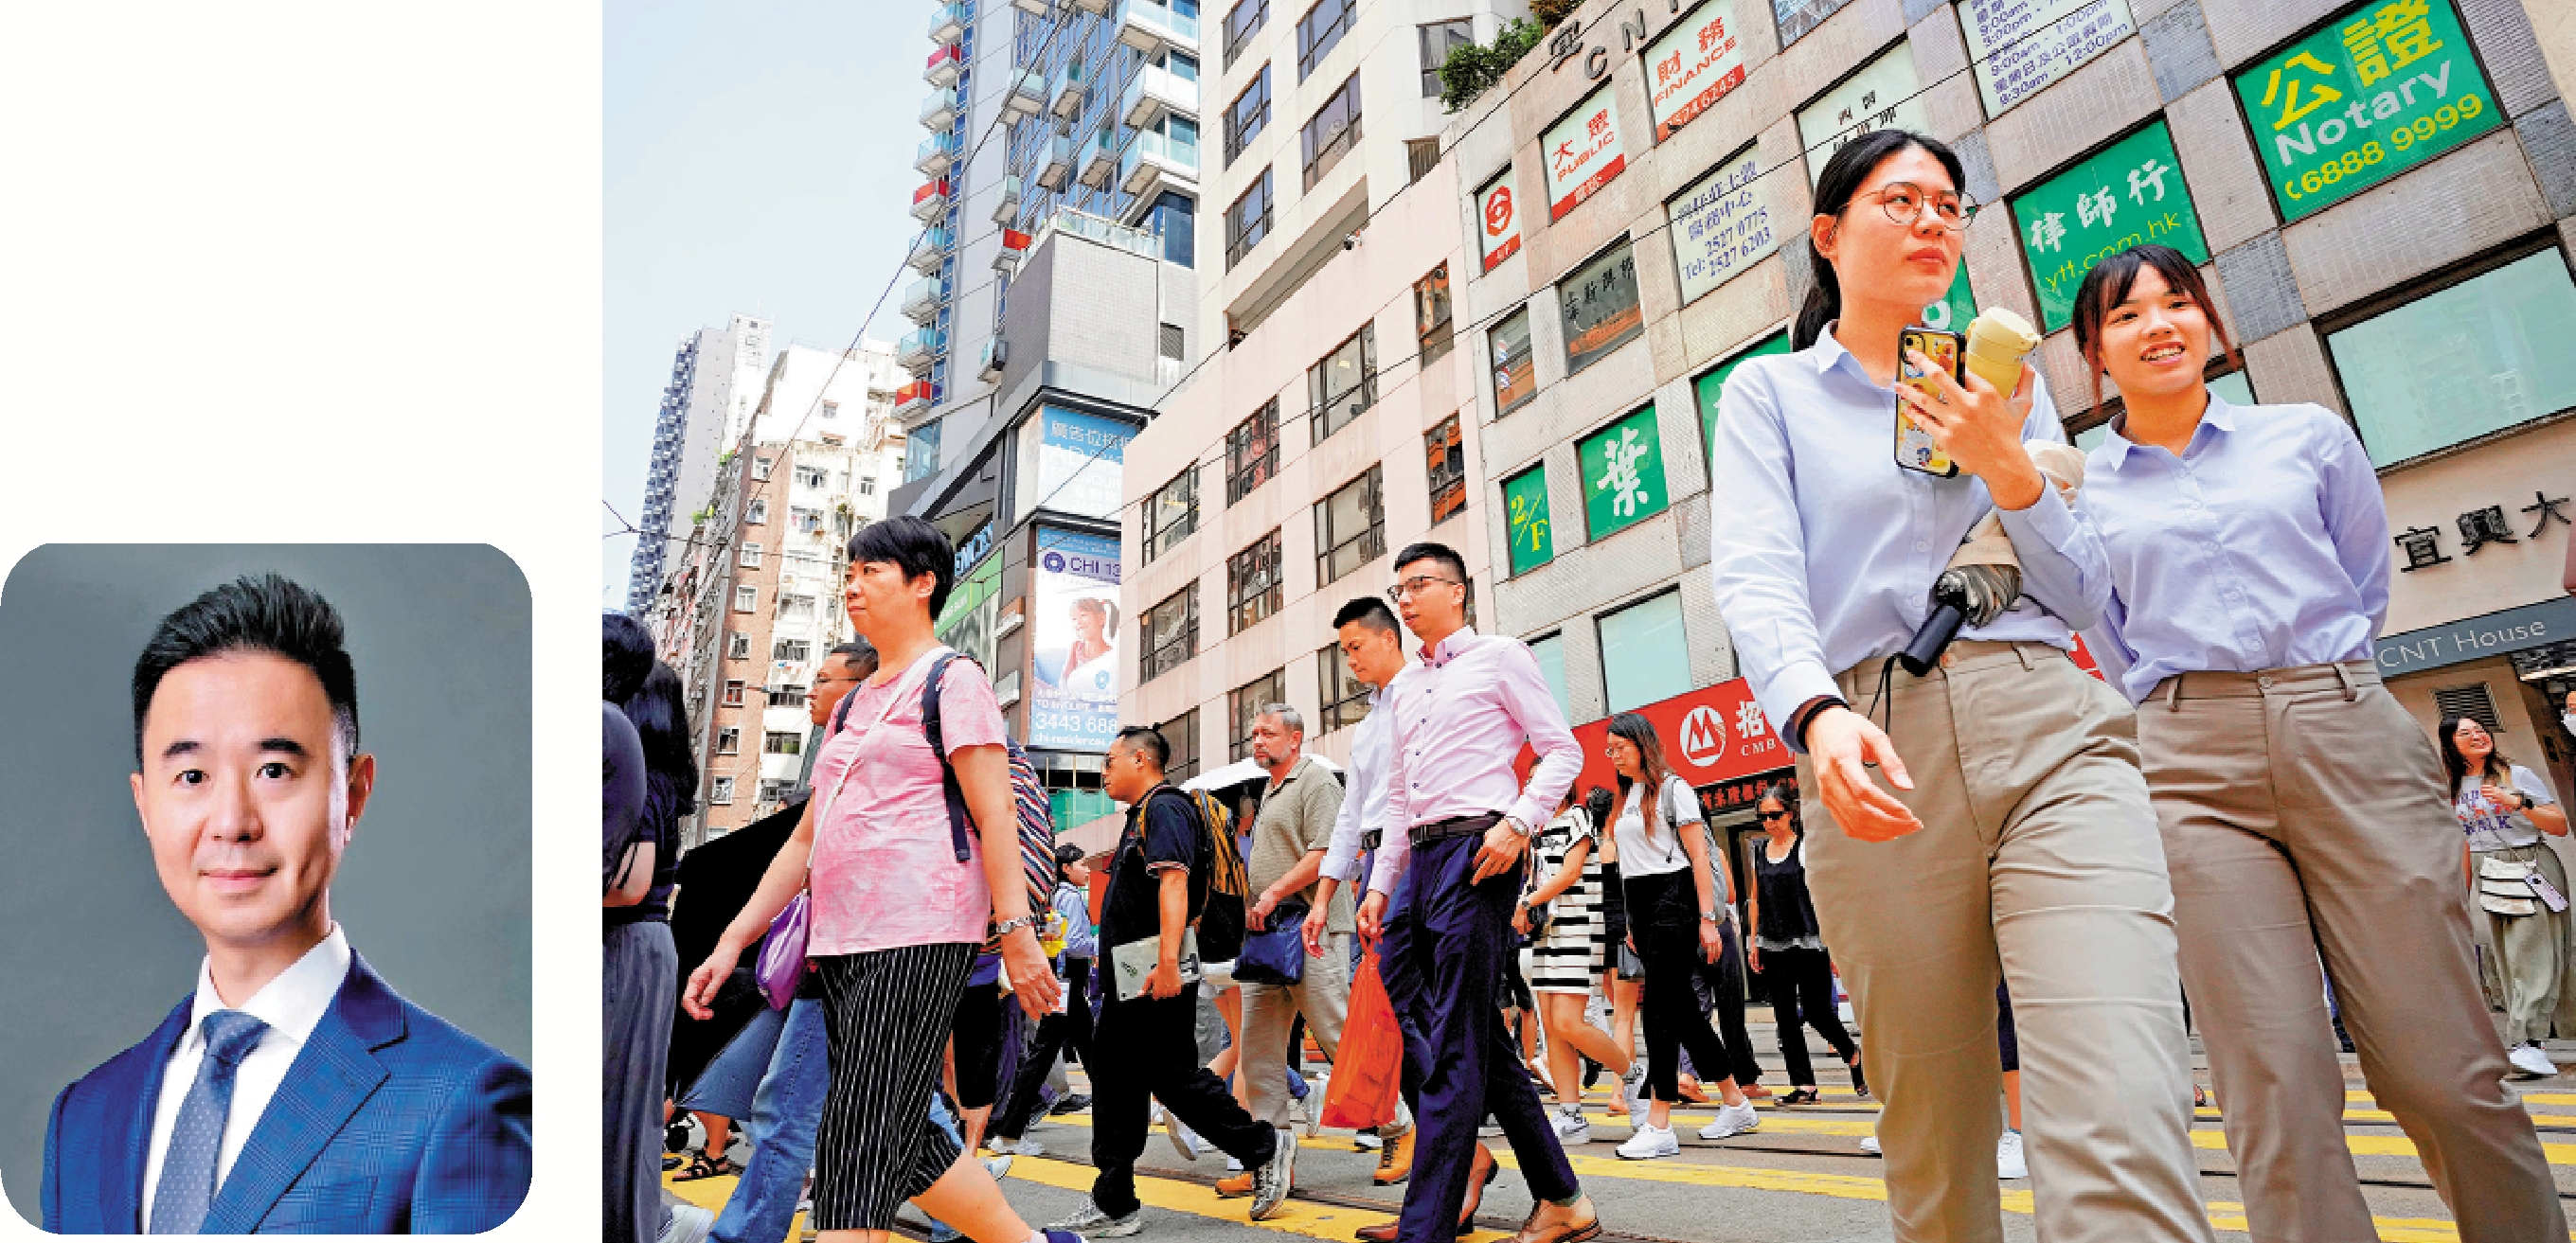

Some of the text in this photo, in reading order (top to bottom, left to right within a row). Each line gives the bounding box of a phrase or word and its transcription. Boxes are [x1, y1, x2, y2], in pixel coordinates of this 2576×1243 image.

[1654, 35, 1738, 107] FINANCE
[1656, 16, 1726, 87] 財務
[2064, 23, 2128, 66] 12:00pm
[2261, 0, 2444, 131] 公證
[1551, 108, 1610, 170] 大眾
[2274, 59, 2451, 167] Notary
[2300, 93, 2483, 194] 6888 9999
[1557, 131, 1615, 183] PUBLIC
[2030, 158, 2170, 253] 律師行
[1597, 427, 1649, 517] 葉
[1511, 492, 1548, 552] 2/F
[2393, 490, 2572, 574] 宜興大
[1070, 556, 1100, 574] CHI
[2378, 621, 2549, 667] CNT House
[1035, 712, 1081, 732] 3443
[1735, 701, 1766, 739] 招
[1740, 738, 1777, 756] CMB
